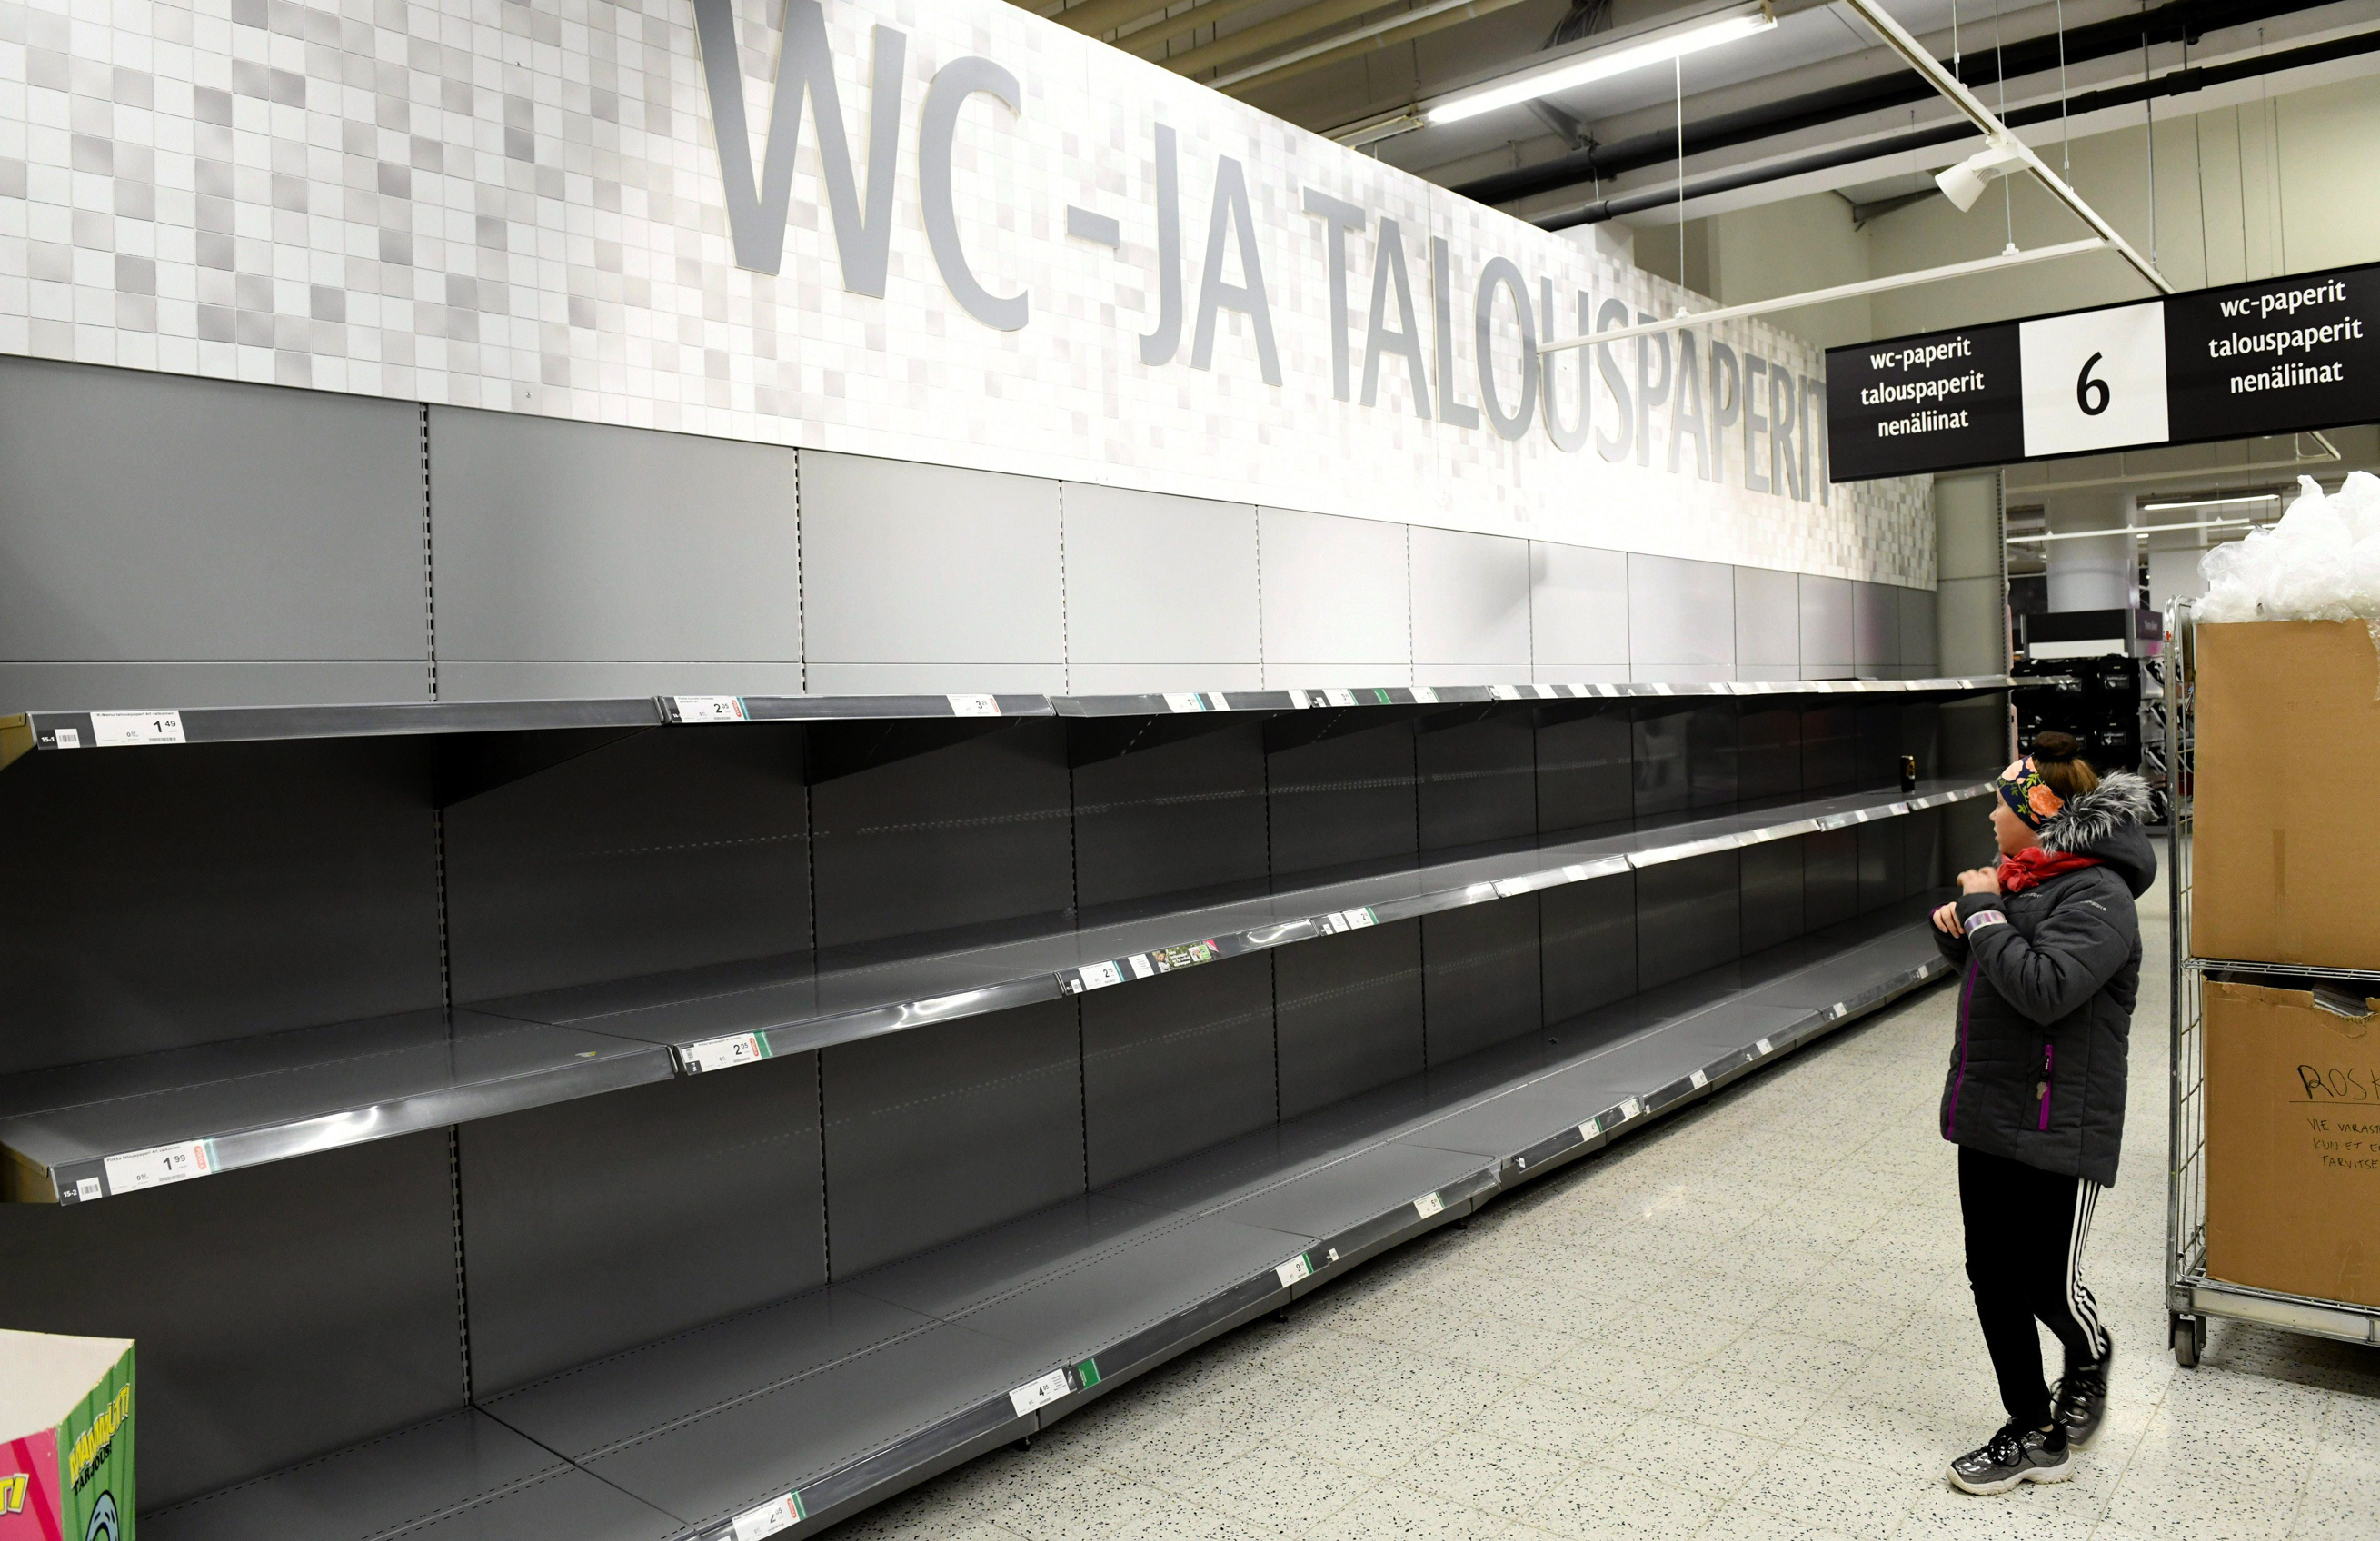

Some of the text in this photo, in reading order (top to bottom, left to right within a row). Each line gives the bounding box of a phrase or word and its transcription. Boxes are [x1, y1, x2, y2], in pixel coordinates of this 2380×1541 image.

[691, 0, 1028, 332] WC
[1302, 185, 1829, 507] TALOUSPAPERIT
[2220, 279, 2346, 319] wc-paperit
[1870, 336, 1971, 371] wc-paperit
[2208, 316, 2363, 358] talouspaperit
[1860, 370, 1985, 405] talouspaperit
[2076, 352, 2110, 416] 6
[2230, 362, 2344, 393] nenäliinat
[1878, 410, 1969, 437] nenäliinat
[2307, 1118, 2380, 1134] VIE VARAST
[2313, 1138, 2380, 1152] KUN ET E
[2320, 1155, 2378, 1169] TARVITSE
[74, 1440, 112, 1496] TARJOUS!
